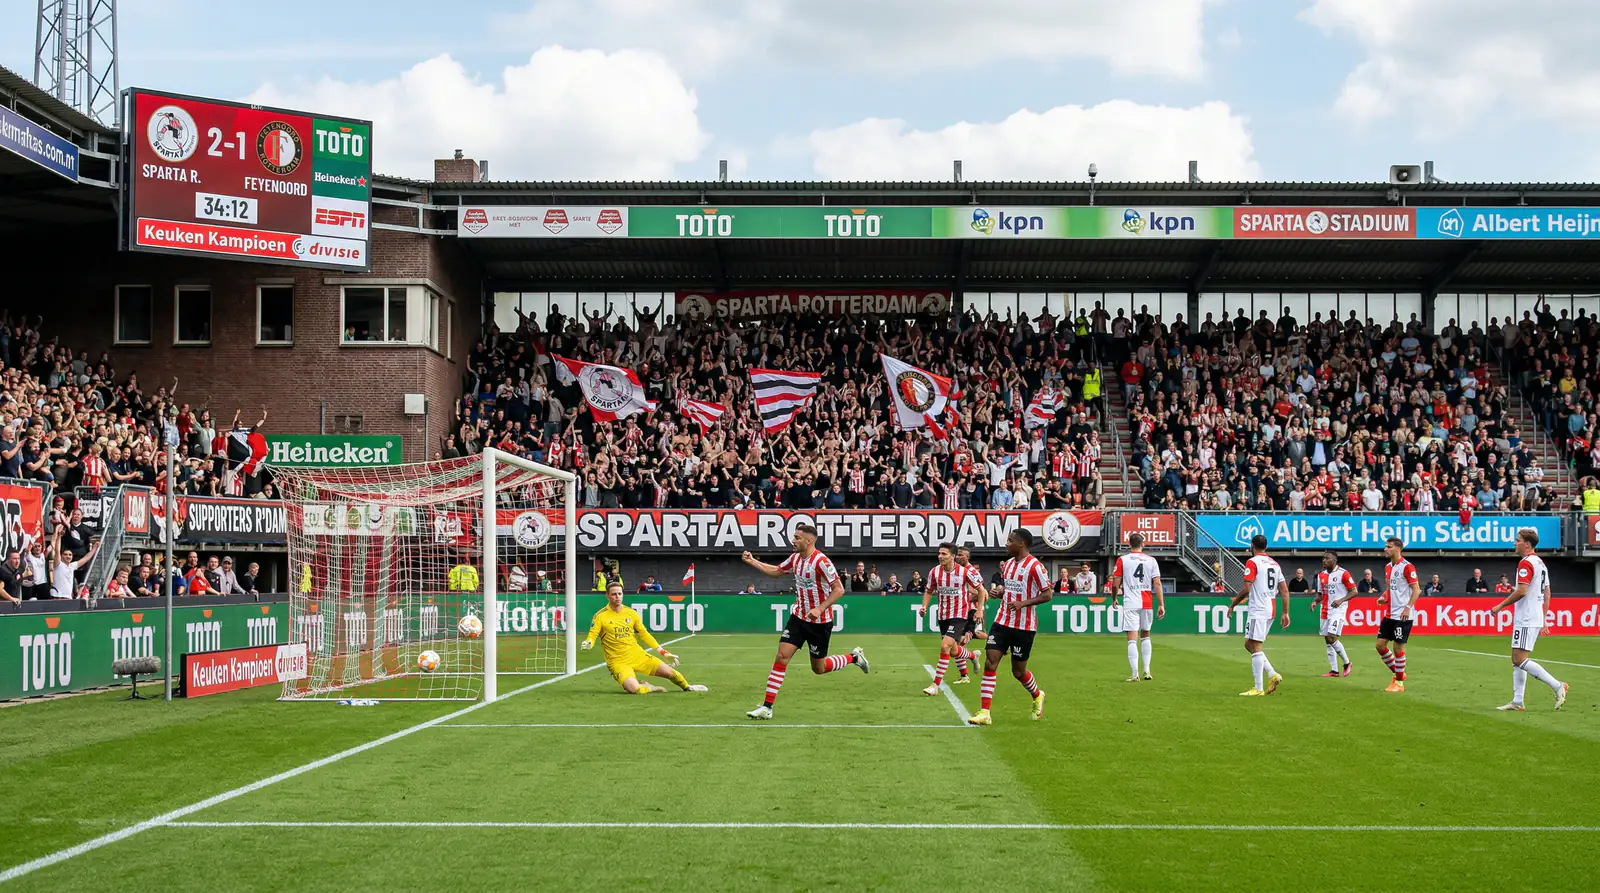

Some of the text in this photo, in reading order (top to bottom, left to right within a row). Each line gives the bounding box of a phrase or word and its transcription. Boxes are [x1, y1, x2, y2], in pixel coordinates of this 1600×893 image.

[208, 127, 246, 160] 2-1
[316, 129, 364, 157] TOTO
[142, 164, 202, 184] SPARTA R.
[314, 172, 357, 185] Heineken
[244, 177, 308, 197] FEYENOORD
[204, 197, 249, 220] 34:12
[315, 208, 365, 228] ESPN
[676, 215, 732, 236] TOTO
[824, 215, 880, 236] TOTO
[999, 212, 1043, 234] kpn
[1150, 212, 1194, 235] kpn
[1240, 214, 1409, 231] SPARTA STADIUM
[1472, 214, 1540, 232] Albert
[144, 224, 360, 259] Keuken Kampioen divisie
[716, 294, 917, 318] SPARTA ROTTERDAM
[271, 442, 389, 463] Heineken
[189, 503, 252, 532] SUPPORTERS
[256, 507, 287, 534] R'DAM
[1137, 517, 1159, 528] HET
[579, 513, 1020, 548] SPARTA ROTTERDAM
[1124, 531, 1173, 542] KSTEEL
[1273, 520, 1352, 542] Albert
[1361, 520, 1426, 547] Heijn
[1133, 563, 1145, 583] 4
[1267, 567, 1276, 590] 6
[631, 603, 704, 631] TOTO
[1052, 605, 1123, 632] TOTO
[1194, 605, 1248, 633] TOT
[1514, 630, 1520, 639] 8
[20, 632, 72, 691] TOTO
[193, 658, 228, 687] Keuken
[230, 653, 273, 684] Kampioen
